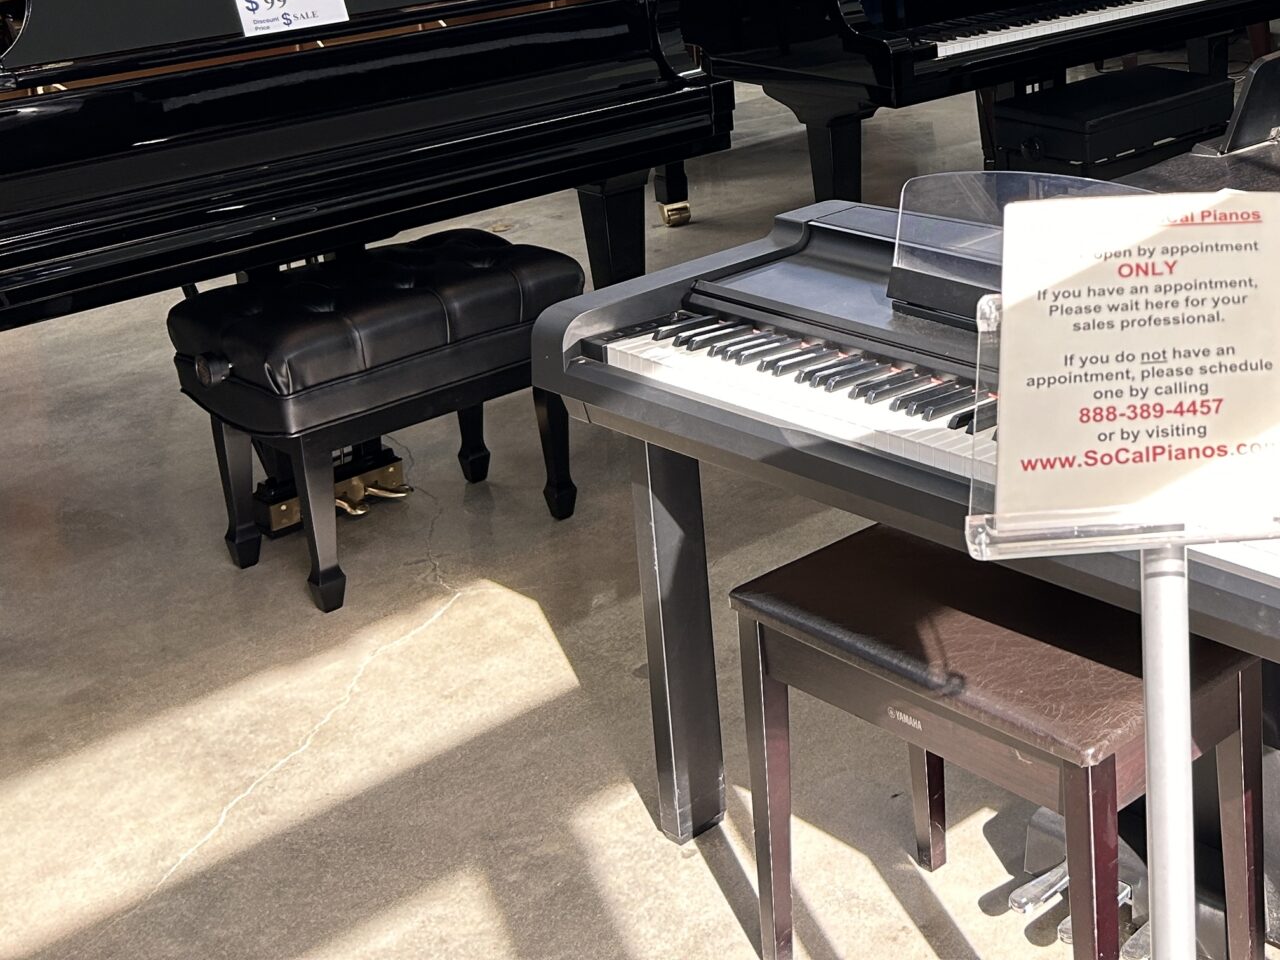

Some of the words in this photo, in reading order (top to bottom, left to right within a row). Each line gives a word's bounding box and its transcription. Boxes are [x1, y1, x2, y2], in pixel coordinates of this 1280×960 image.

[253, 16, 280, 25] Discount
[1200, 209, 1262, 222] Pianos
[1137, 245, 1156, 259] by
[1160, 240, 1259, 256] appointment
[1117, 259, 1178, 278] ONLY
[1037, 289, 1048, 301] If
[1052, 288, 1081, 302] you
[1087, 286, 1125, 297] have
[1130, 285, 1149, 295] an
[1154, 277, 1258, 295] appointment,
[1048, 304, 1102, 317] Please
[1107, 299, 1140, 313] wait
[1145, 298, 1180, 310] here
[1185, 295, 1207, 307] for
[1211, 294, 1248, 308] your
[1072, 318, 1115, 332] sales
[1120, 311, 1225, 331] professional.
[1064, 354, 1075, 366] If
[1079, 354, 1109, 368] you
[1115, 350, 1136, 363] do
[1140, 348, 1167, 363] not
[1172, 347, 1211, 359] have
[1216, 345, 1235, 356] an
[1026, 368, 1136, 389] appointment,
[1141, 365, 1194, 382] please
[1199, 358, 1273, 375] schedule
[1093, 388, 1124, 400] one
[1129, 385, 1149, 399] by
[1154, 381, 1209, 396] calling
[1078, 398, 1224, 424] 888-389-4457
[1097, 431, 1115, 442] or
[1120, 427, 1140, 443] by
[1145, 423, 1207, 438] visiting
[1020, 442, 1277, 472] www.SoCalPianos.co
[895, 709, 923, 732] YAMAHA
